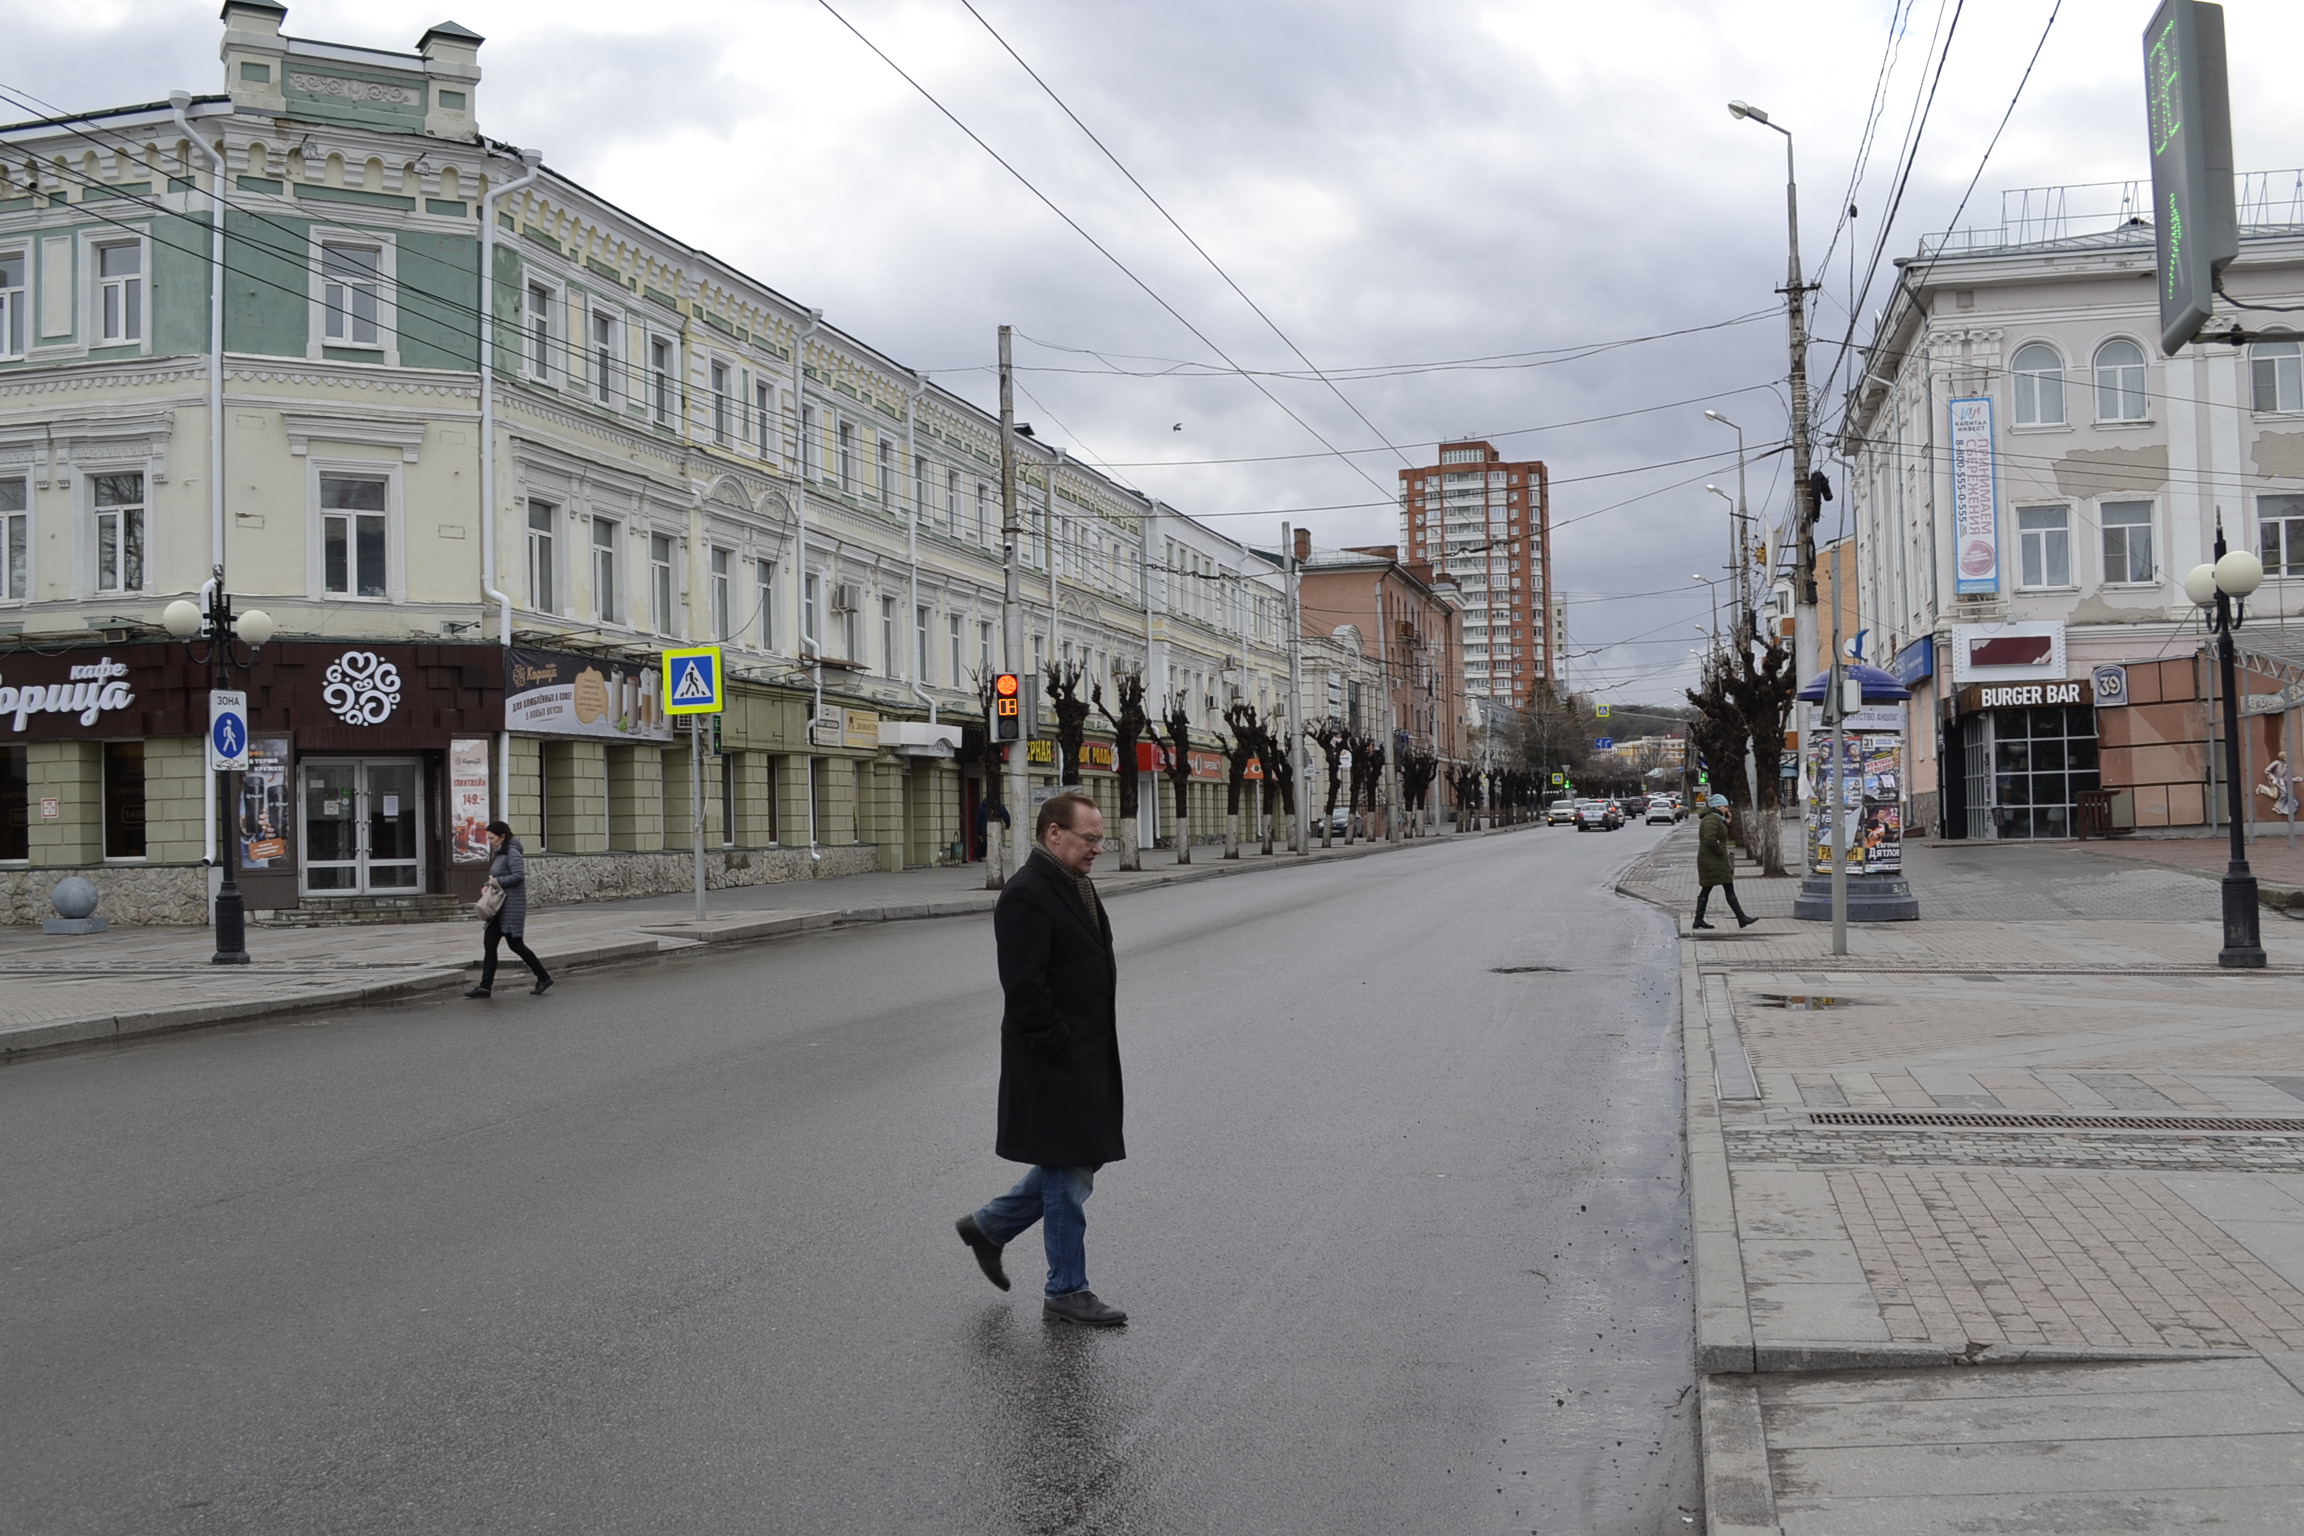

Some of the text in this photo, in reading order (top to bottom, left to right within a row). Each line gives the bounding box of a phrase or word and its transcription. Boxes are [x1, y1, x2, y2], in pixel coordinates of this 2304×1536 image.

[1955, 439, 1967, 523] 8-800-555-0-555
[1965, 438, 1980, 535] СБЕРЕЖЕНИЯ
[1977, 438, 1992, 535] ПРИНИМАЕМ
[70, 656, 129, 685] кафе
[1981, 683, 2080, 707] BURGER BAR
[2098, 675, 2122, 697] 39
[0, 672, 136, 732] орица
[217, 696, 240, 706] ЗОНА
[512, 700, 522, 713] ДЛЯ
[998, 698, 1018, 716] 08
[1864, 738, 1873, 747] 31
[454, 777, 486, 788] ГЛИНТВЕЙН
[1889, 808, 1898, 816] 12
